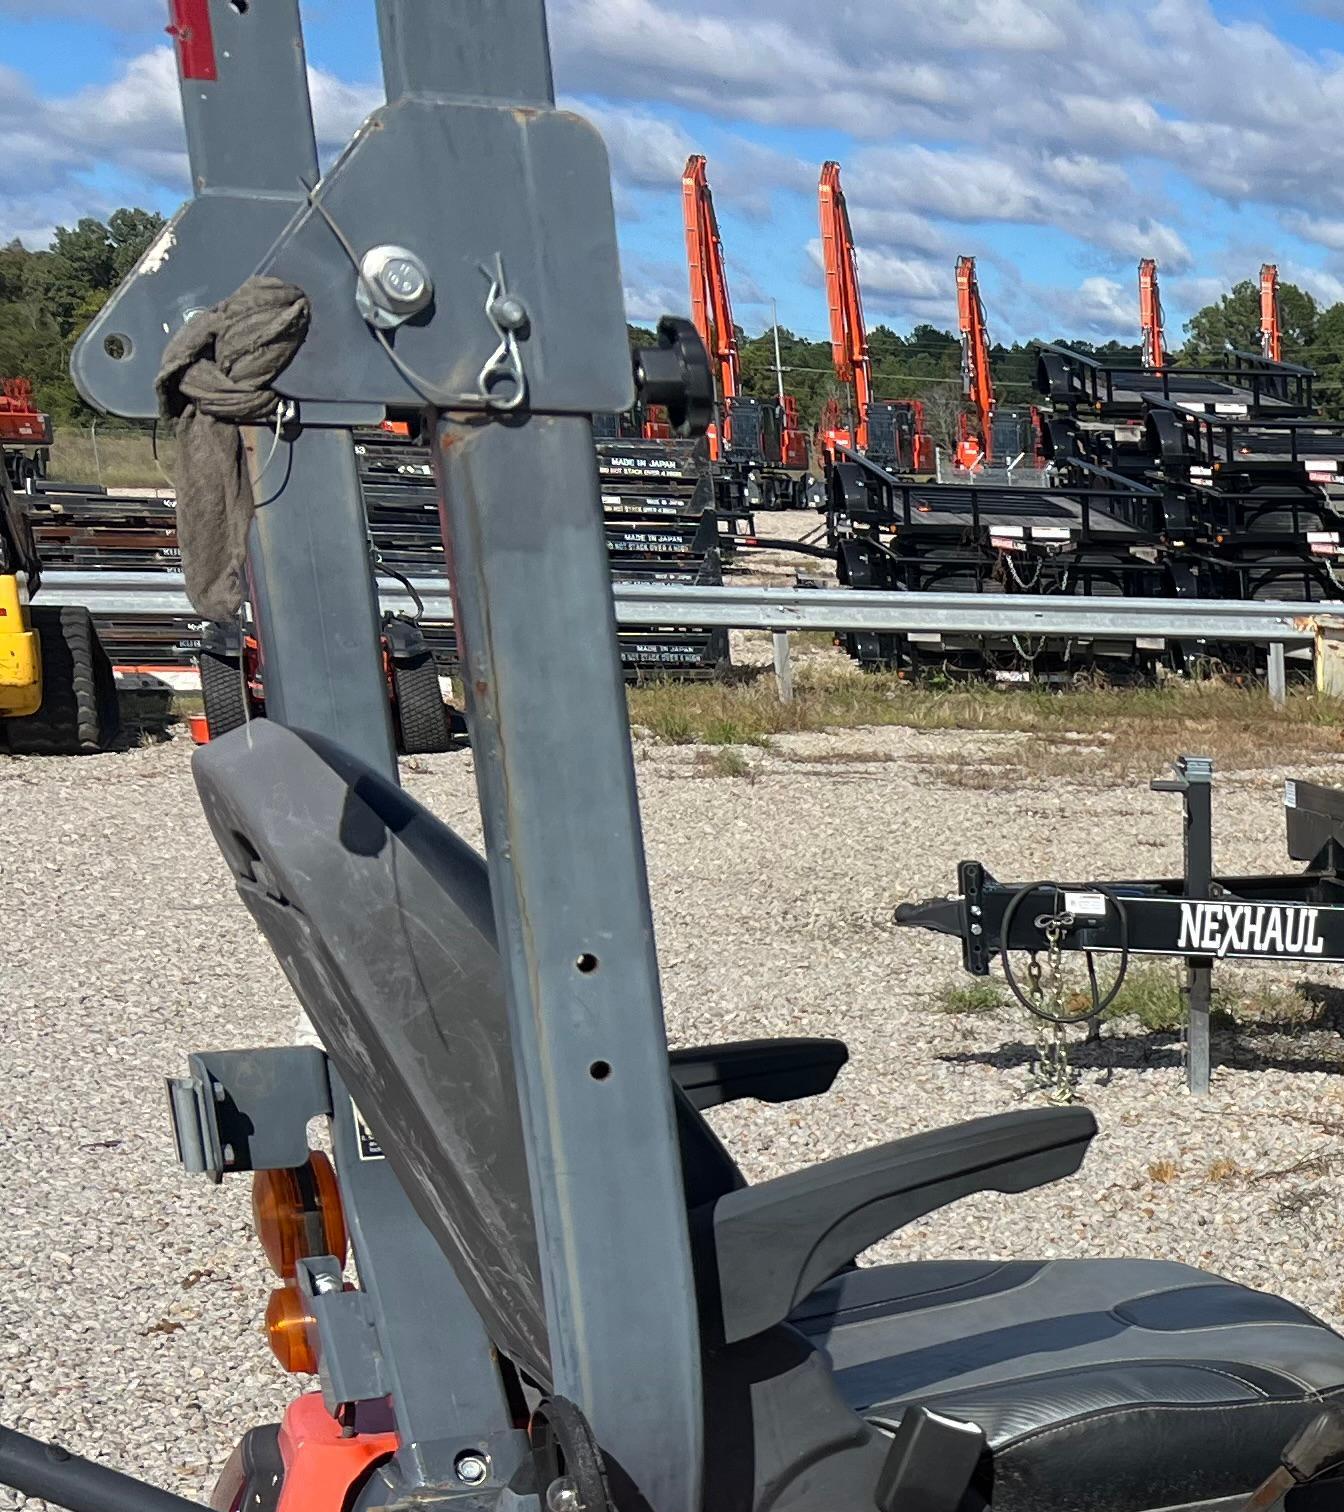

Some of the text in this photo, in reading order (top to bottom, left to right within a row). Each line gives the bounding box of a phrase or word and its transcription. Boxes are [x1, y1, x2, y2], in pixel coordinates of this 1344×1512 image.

[637, 459, 646, 467] IN
[649, 460, 676, 469] JAPAN
[1177, 904, 1324, 957] NEXHAUL
